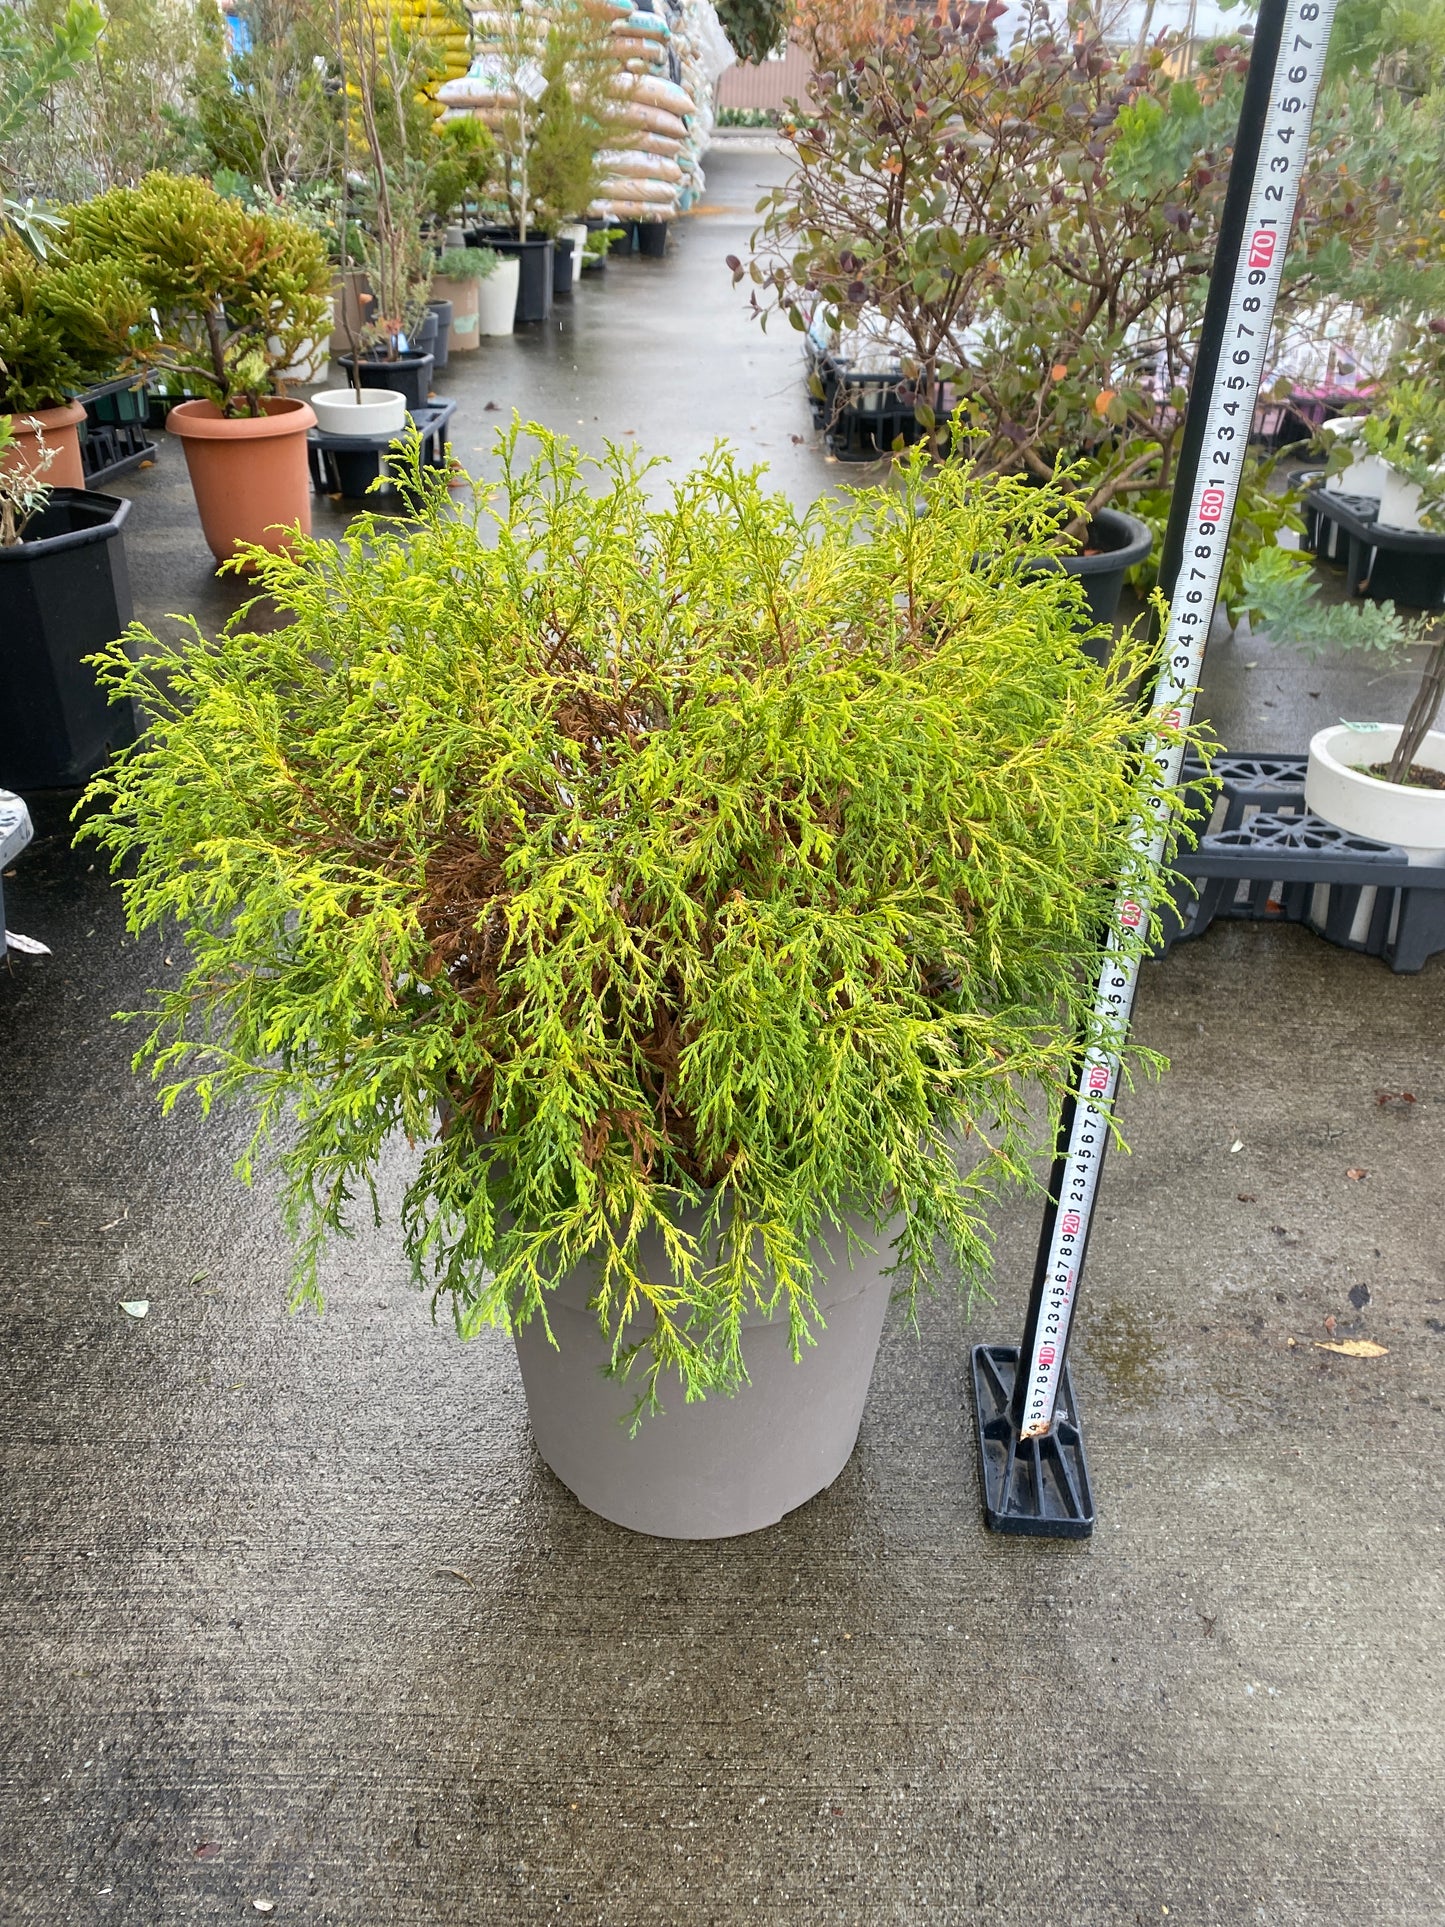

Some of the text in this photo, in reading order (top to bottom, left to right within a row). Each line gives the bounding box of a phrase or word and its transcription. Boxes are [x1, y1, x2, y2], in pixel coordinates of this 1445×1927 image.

[1299, 3, 1321, 22] 8
[1293, 34, 1313, 53] 7
[1288, 65, 1308, 84] 6
[1281, 96, 1301, 114] 5
[1276, 126, 1295, 145] 4
[1270, 156, 1290, 174] 3
[1264, 185, 1284, 202] 2
[1260, 218, 1277, 229] 1
[1250, 233, 1275, 264] 70
[1248, 269, 1267, 286] 9
[1242, 296, 1261, 313] 8
[1236, 323, 1255, 339] 7
[1232, 350, 1250, 365] 6
[1226, 375, 1245, 391] 5
[1222, 401, 1240, 417] 4
[1217, 426, 1235, 441] 3
[1212, 450, 1231, 466] 2
[1208, 478, 1225, 487] 1
[1201, 492, 1223, 518] 60
[1198, 521, 1216, 536] 9
[1194, 545, 1212, 559] 8
[1189, 567, 1207, 581] 7
[1186, 590, 1203, 604] 6
[1181, 612, 1198, 625] 5
[1177, 634, 1194, 648] 4
[1173, 655, 1190, 669] 3
[1168, 675, 1186, 690] 2
[1110, 977, 1125, 987] 6
[1108, 994, 1122, 1004] 5
[1091, 1069, 1108, 1088] 30
[1089, 1090, 1103, 1100] 9
[1086, 1105, 1100, 1115] 8
[1084, 1120, 1097, 1129] 7
[1081, 1134, 1095, 1144] 6
[1078, 1149, 1092, 1159] 5
[1076, 1164, 1089, 1173] 4
[1072, 1178, 1086, 1188] 3
[1070, 1192, 1083, 1202] 2
[1063, 1215, 1079, 1233] 20
[1062, 1234, 1075, 1243] 9
[1059, 1247, 1072, 1256] 8
[1057, 1261, 1069, 1269] 7
[1055, 1274, 1067, 1282] 6
[1052, 1287, 1065, 1296] 5
[1050, 1300, 1062, 1309] 4
[1047, 1313, 1060, 1322] 3
[1045, 1326, 1057, 1334] 2
[1040, 1348, 1055, 1362] 10
[1039, 1363, 1050, 1371] 9
[1036, 1375, 1048, 1383] 8
[1034, 1388, 1045, 1396] 7
[1032, 1400, 1044, 1408] 6
